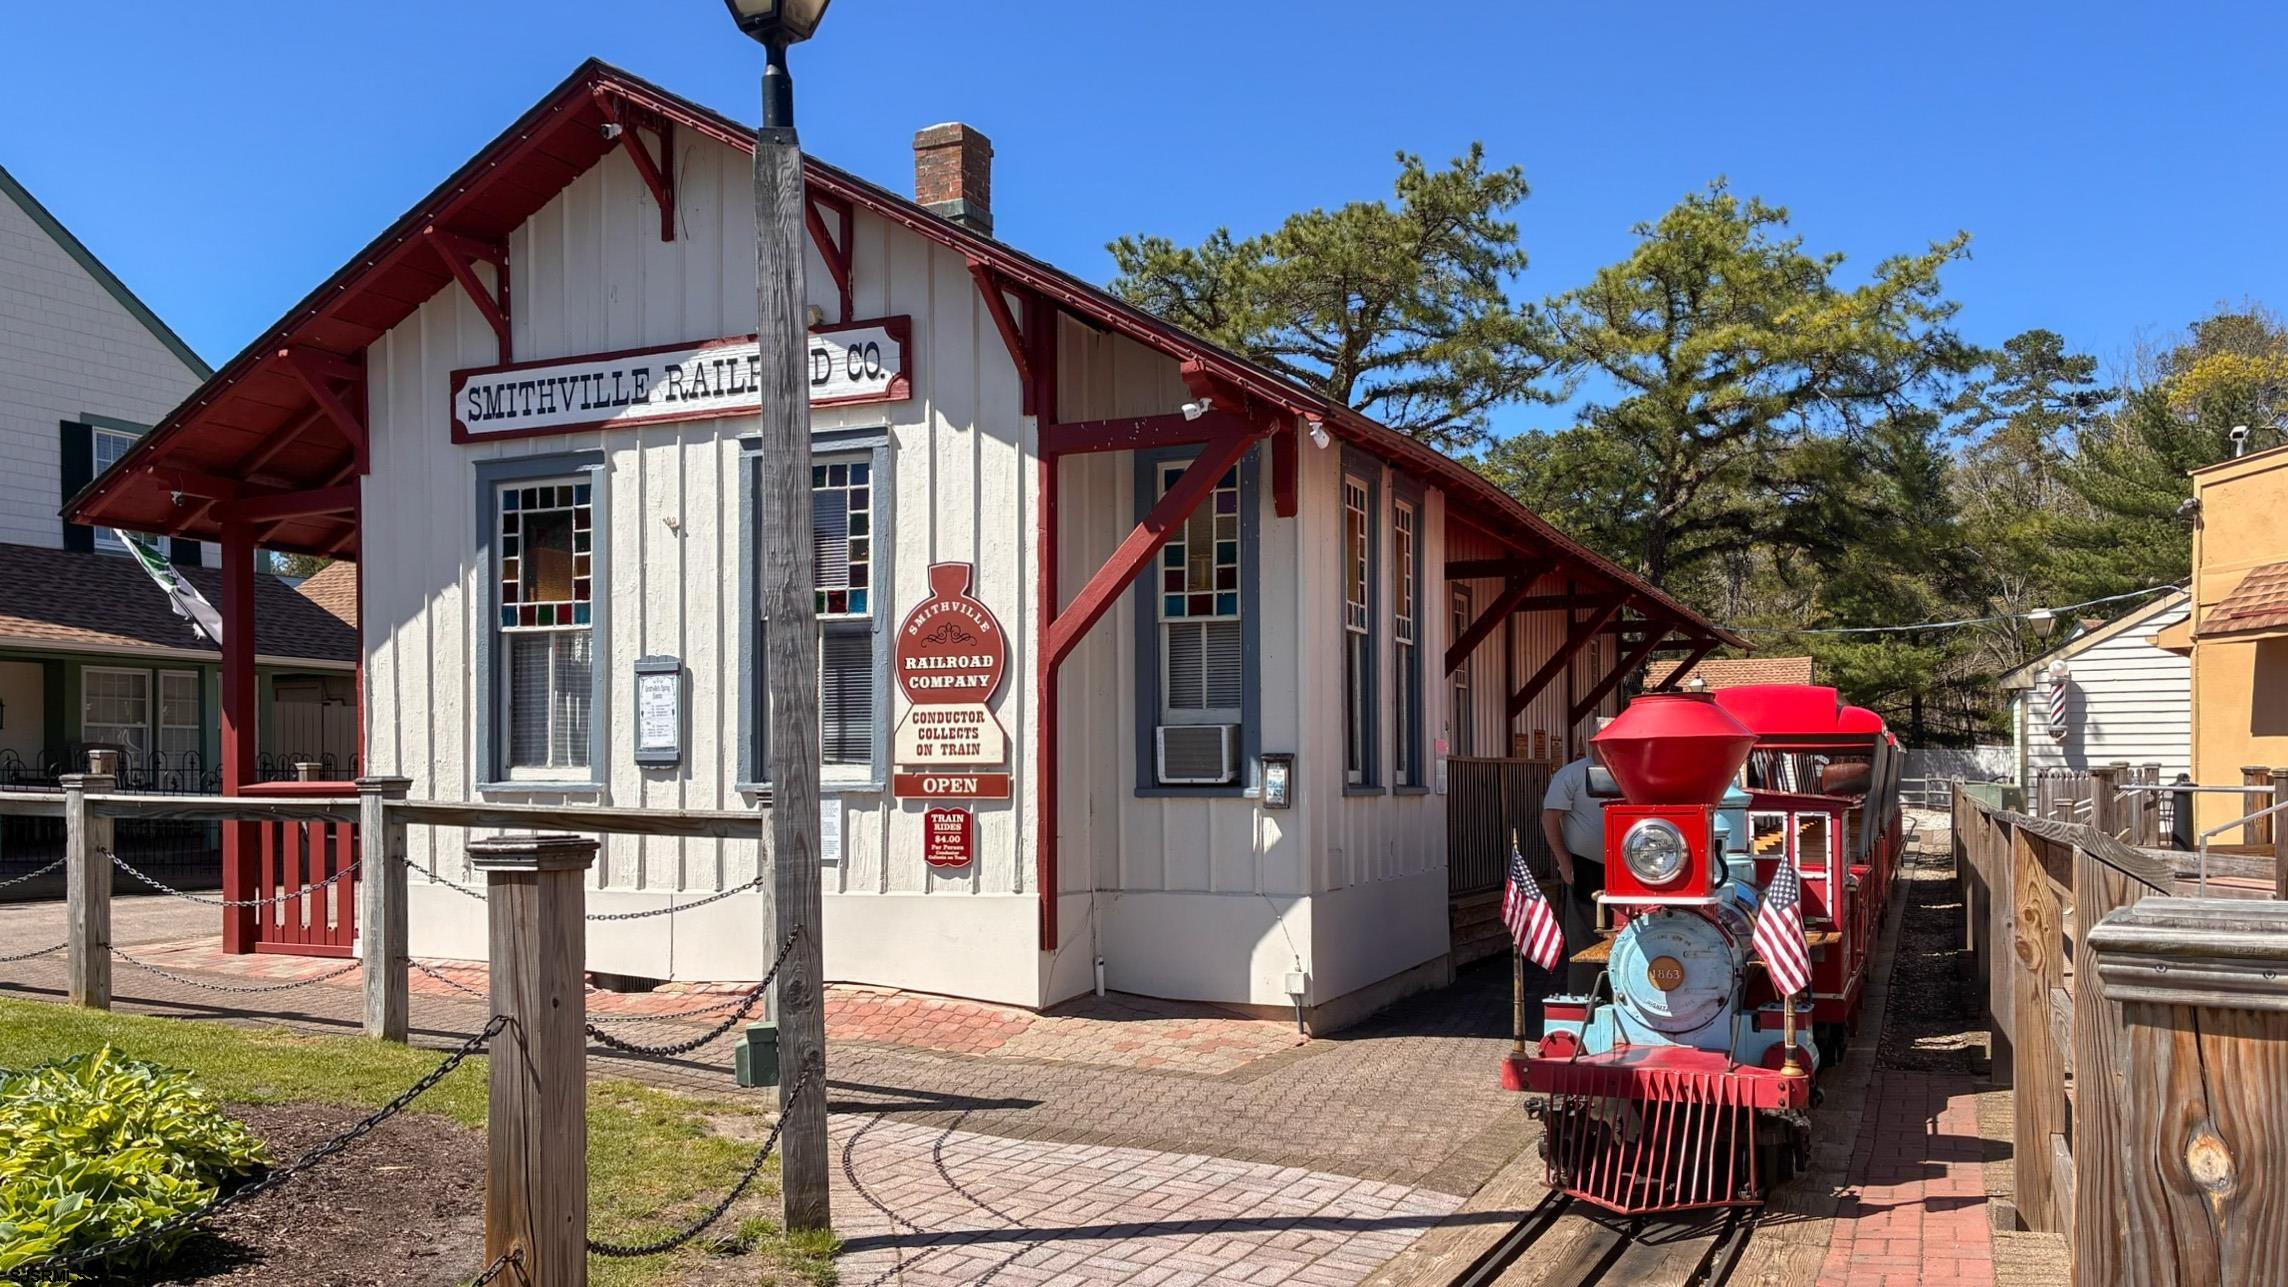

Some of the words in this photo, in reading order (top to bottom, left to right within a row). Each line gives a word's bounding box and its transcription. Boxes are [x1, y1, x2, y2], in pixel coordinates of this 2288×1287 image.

[468, 368, 650, 422] SMITHVILLE
[665, 348, 832, 402] RAILRD
[846, 341, 886, 382] CO.
[908, 601, 991, 636] SMITHVILLE
[904, 655, 994, 670] RAILROAD
[908, 674, 991, 689] COMPANY
[912, 710, 986, 724] CONDUCTOR
[918, 727, 980, 741] COLLECTS
[916, 743, 933, 757] ON
[940, 743, 981, 756] TRAIN
[922, 778, 978, 794] OPEN
[931, 814, 964, 823] TRAIN
[934, 823, 962, 831] RIDES
[935, 835, 961, 843] $4.00
[1651, 969, 1681, 980] 1863
